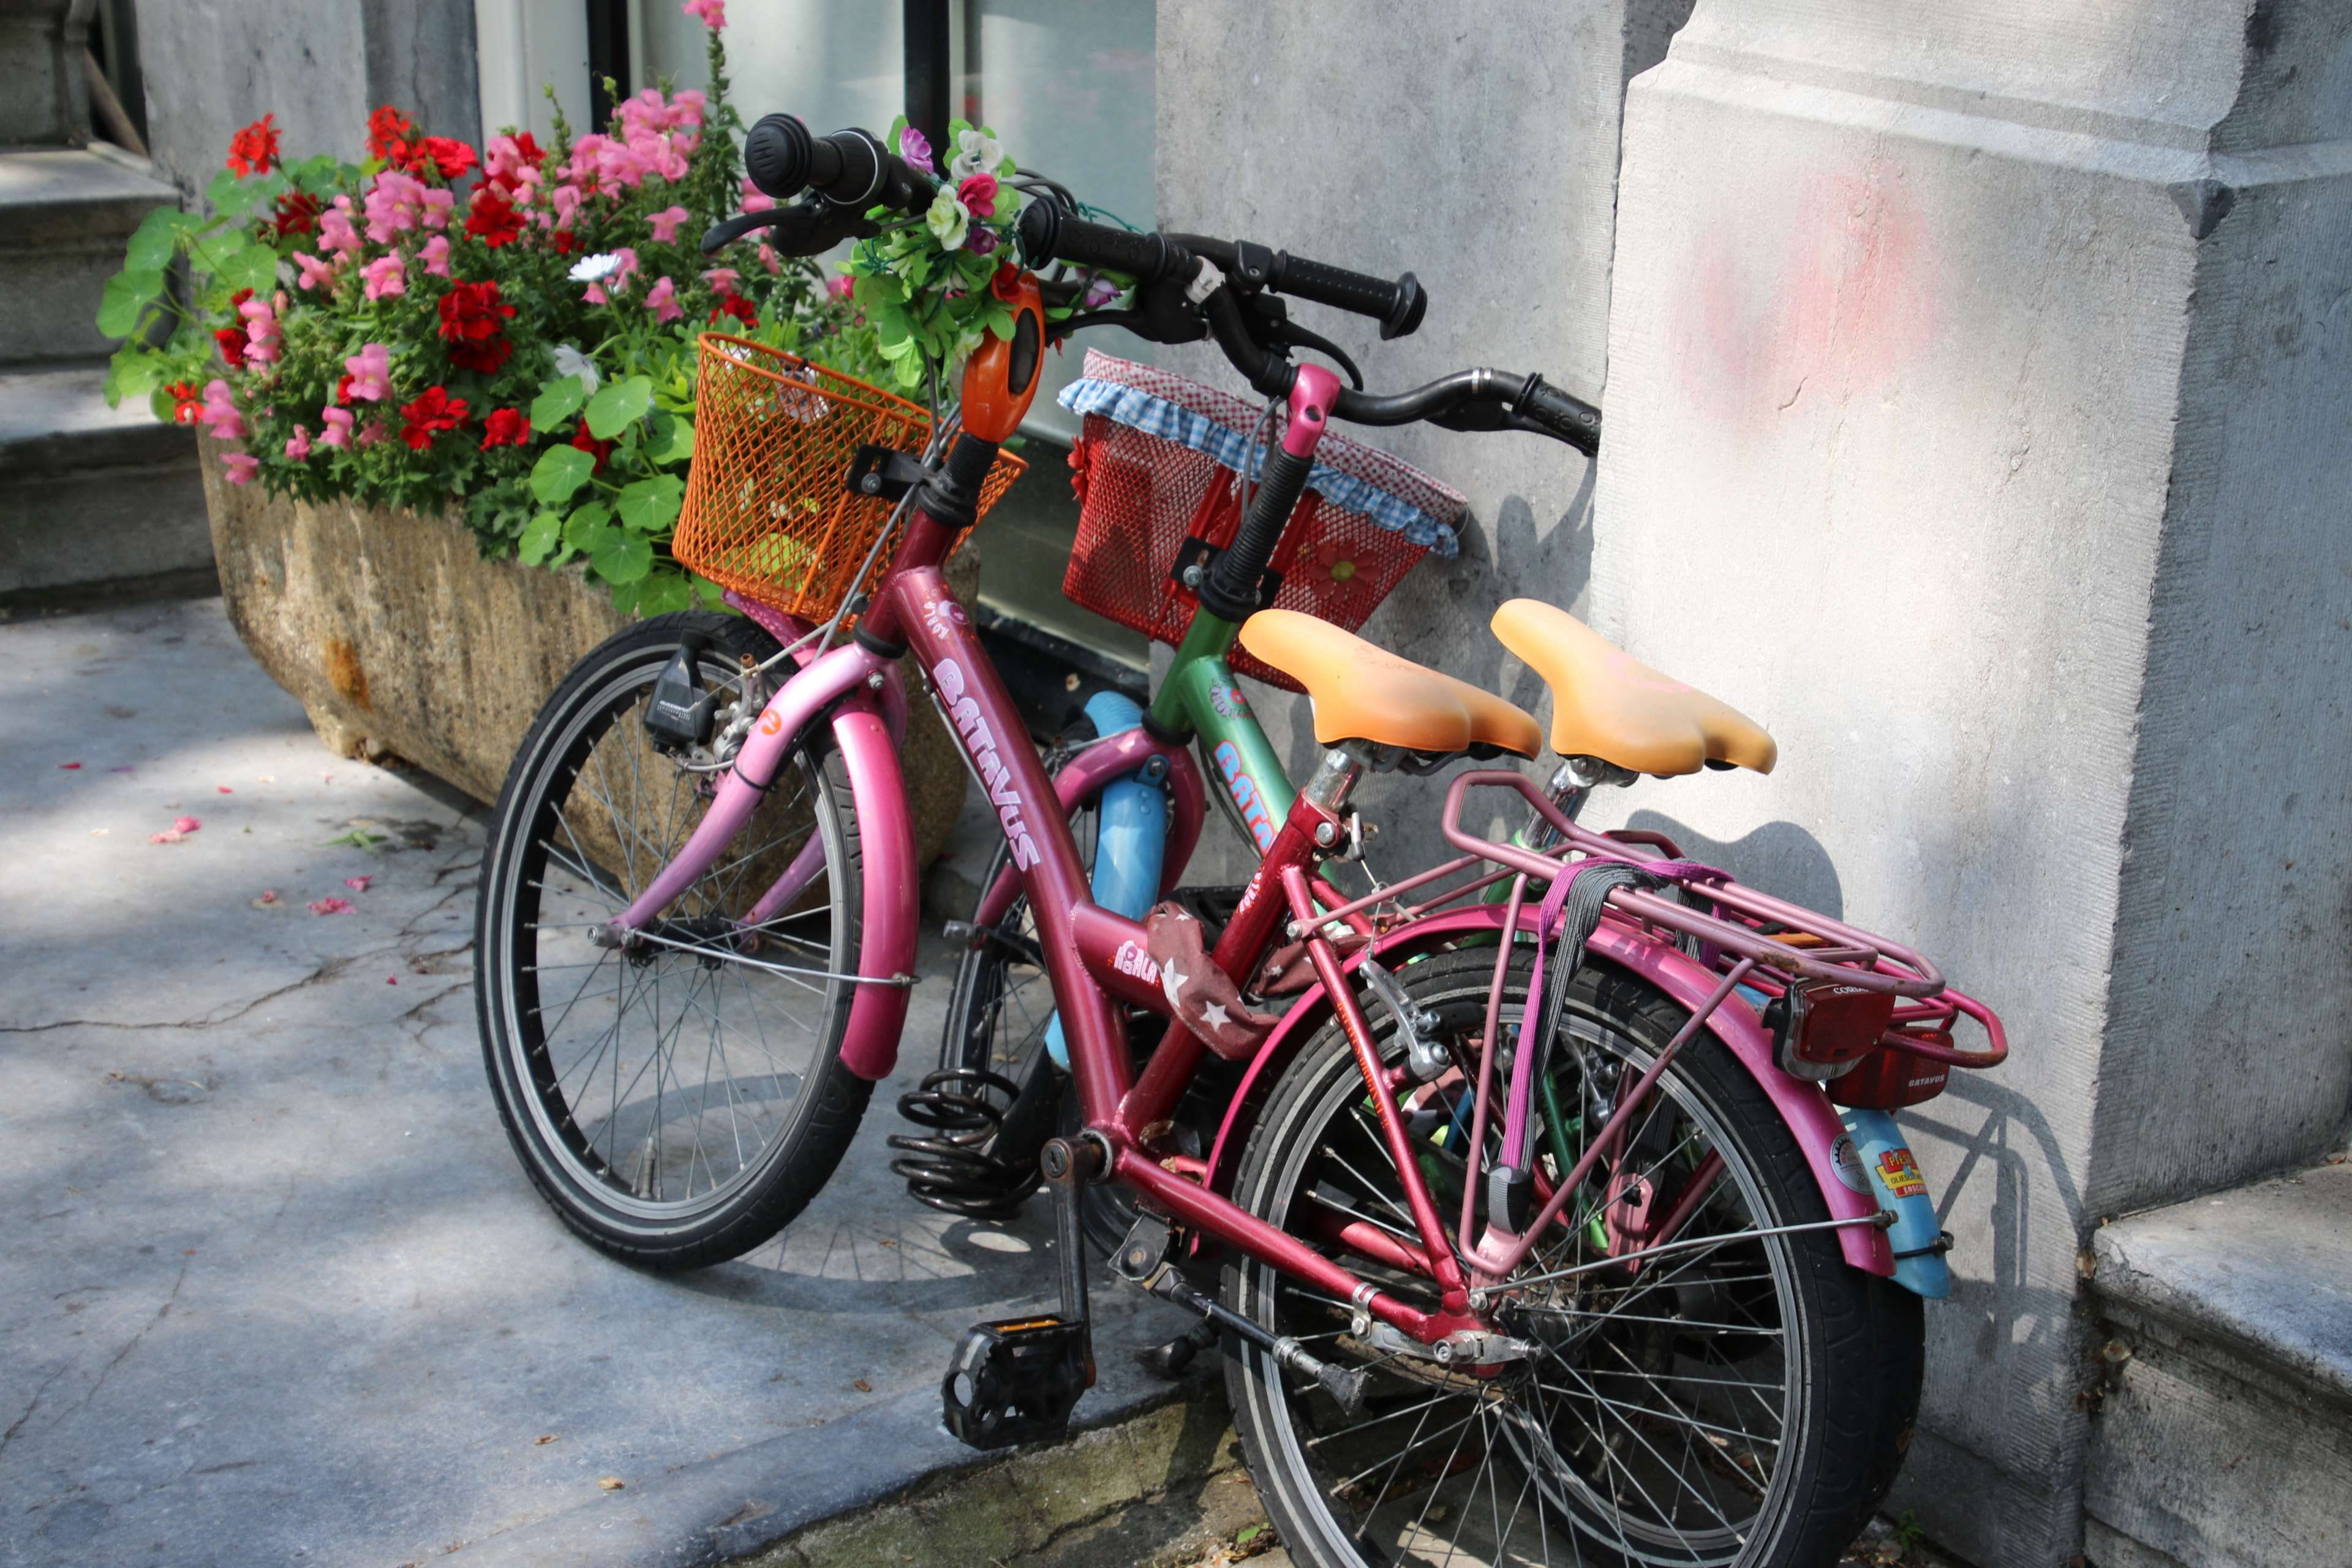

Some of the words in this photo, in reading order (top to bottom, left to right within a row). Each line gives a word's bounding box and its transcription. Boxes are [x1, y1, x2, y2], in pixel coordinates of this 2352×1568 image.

[933, 658, 1041, 872] BATAVUS
[1213, 739, 1278, 859] BATA
[1114, 944, 1158, 984] KOALA
[1908, 1074, 1945, 1087] BATAVUS
